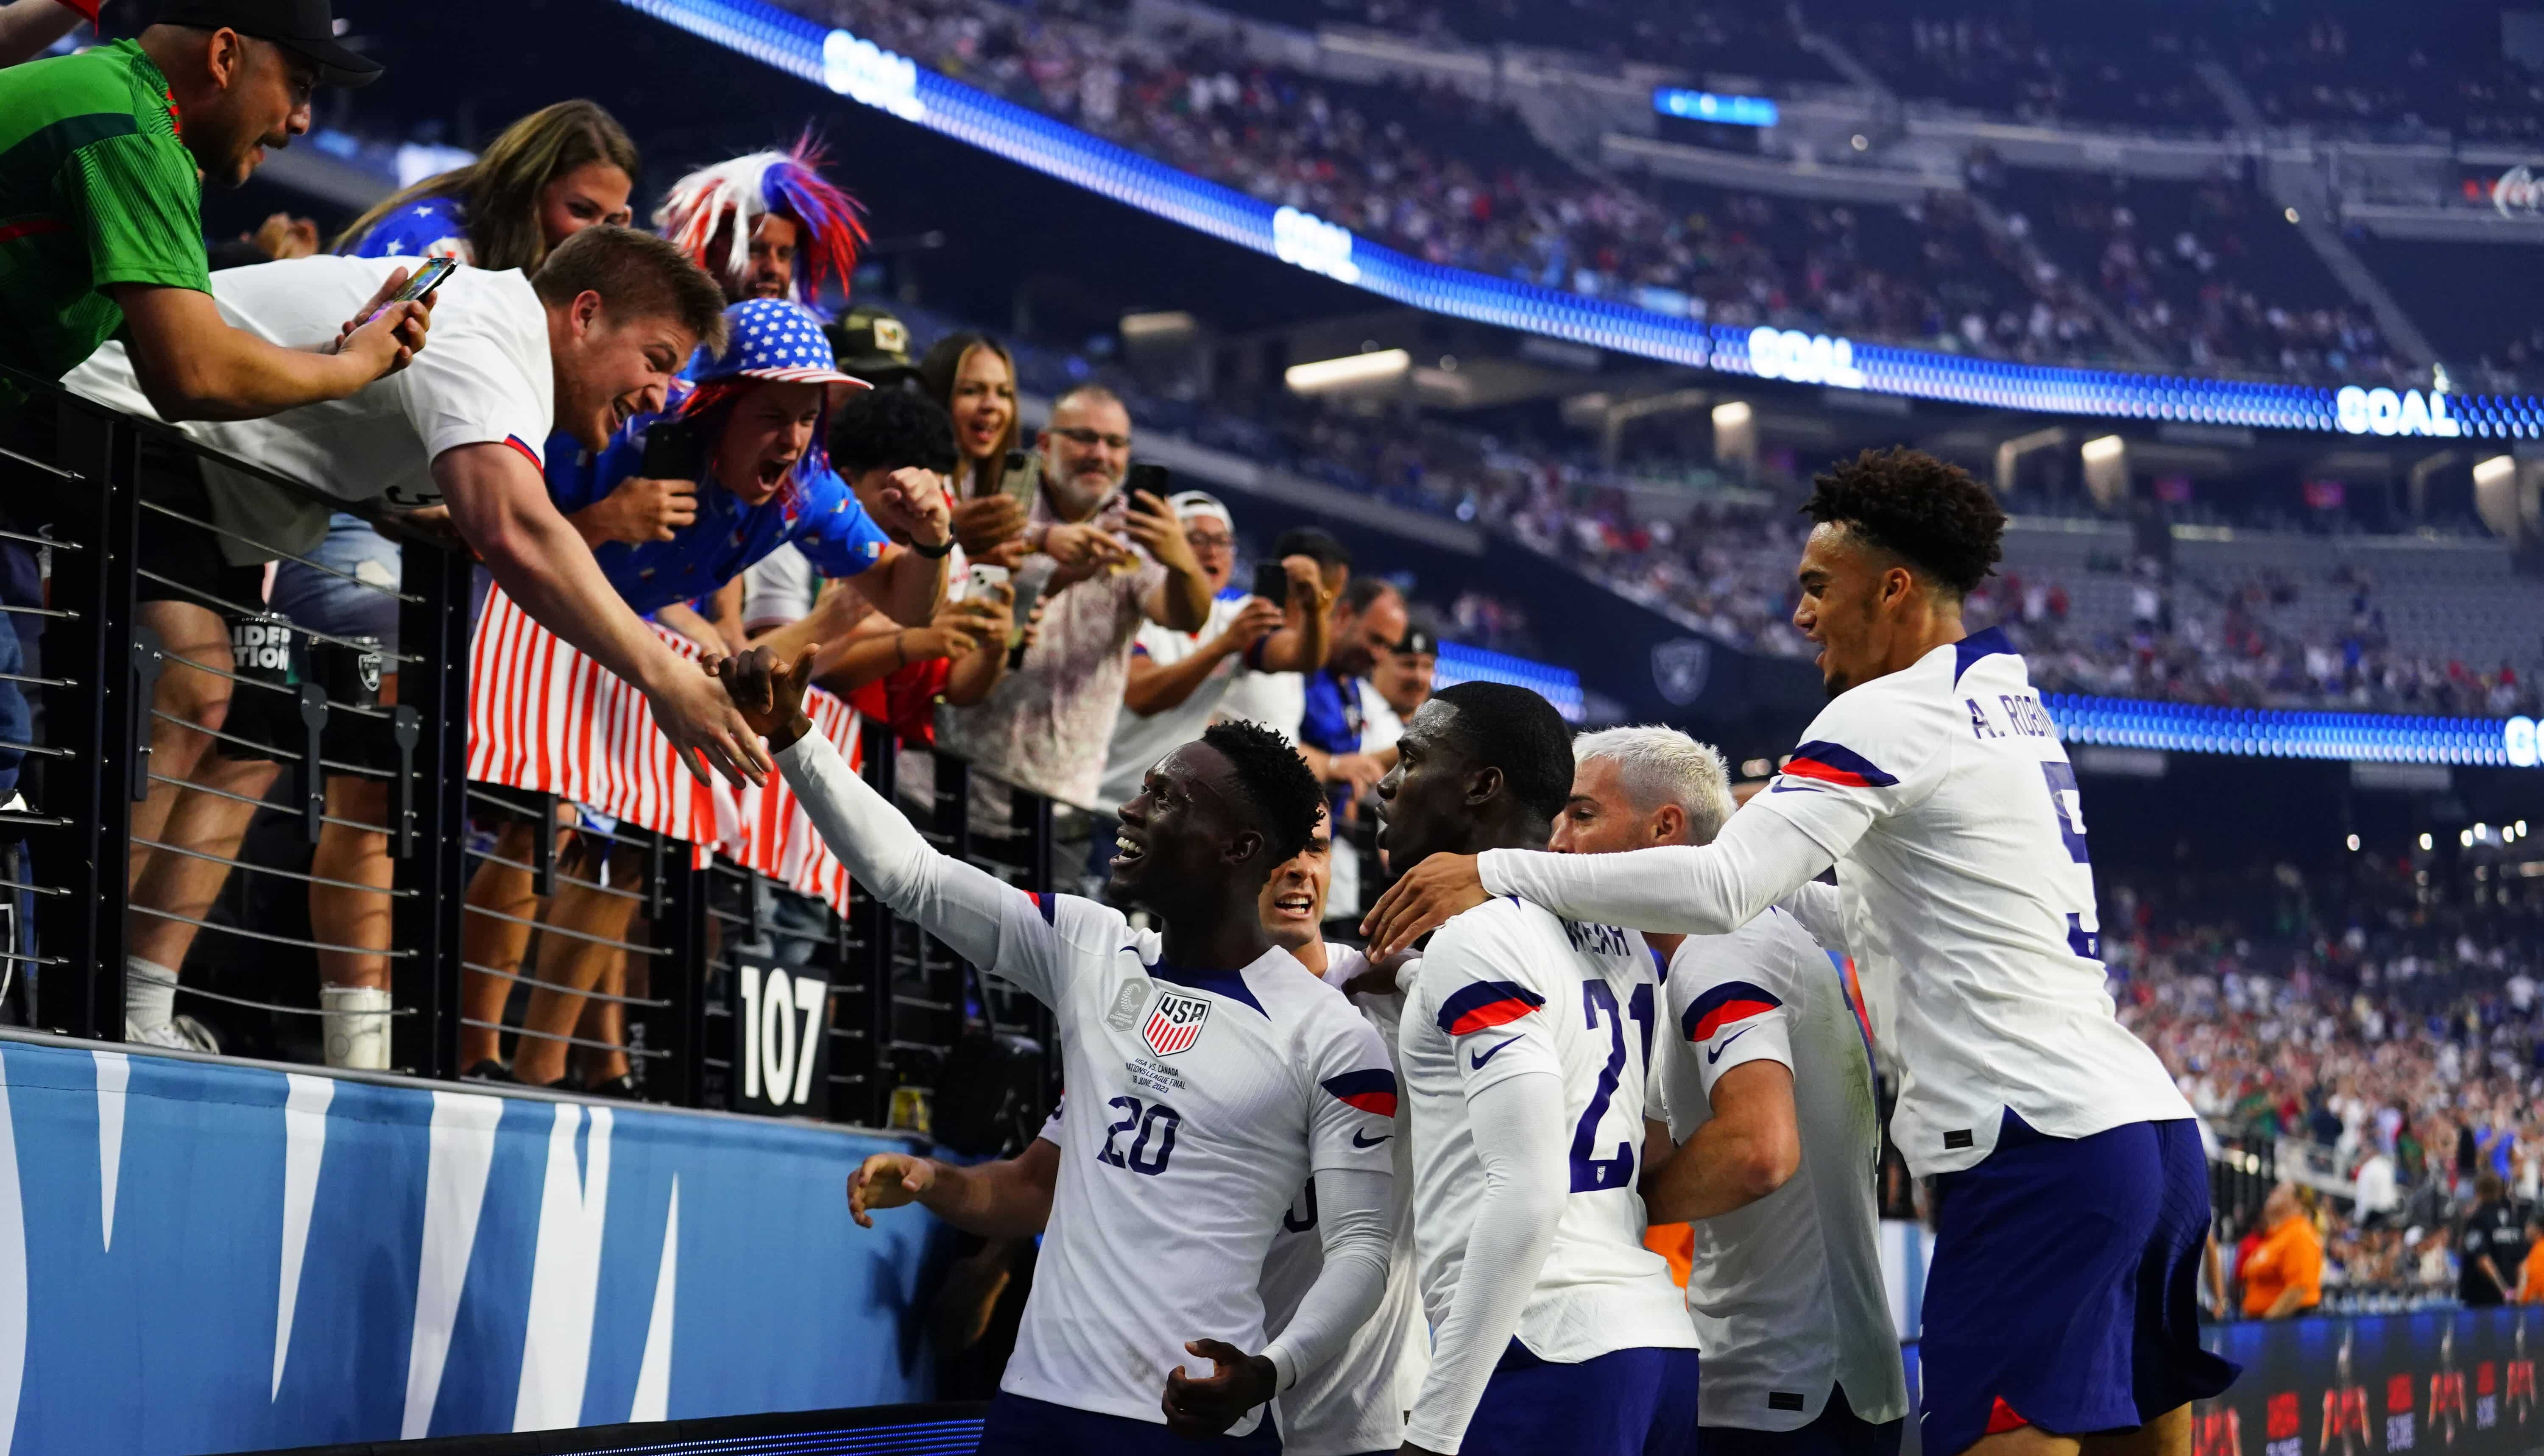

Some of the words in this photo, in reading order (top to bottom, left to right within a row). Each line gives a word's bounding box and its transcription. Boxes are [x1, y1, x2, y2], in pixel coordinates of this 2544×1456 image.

[1749, 326, 1864, 389] GOAL
[2337, 385, 2461, 437] GOAL
[1965, 698, 2005, 739] A.
[1160, 997, 1206, 1024] USA
[741, 966, 827, 1107] 107
[1126, 1062, 1147, 1075] NATIONS
[1146, 1071, 1170, 1084] LEAGUE
[1169, 1079, 1186, 1090] FINAL
[1135, 1058, 1147, 1066] USA
[1149, 1063, 1157, 1071] VS.
[1158, 1065, 1179, 1077] CANADA
[1138, 1077, 1153, 1087] JUNE
[1152, 1083, 1169, 1094] 2023
[1569, 979, 1654, 1193] 21
[1096, 1096, 1180, 1176] 20
